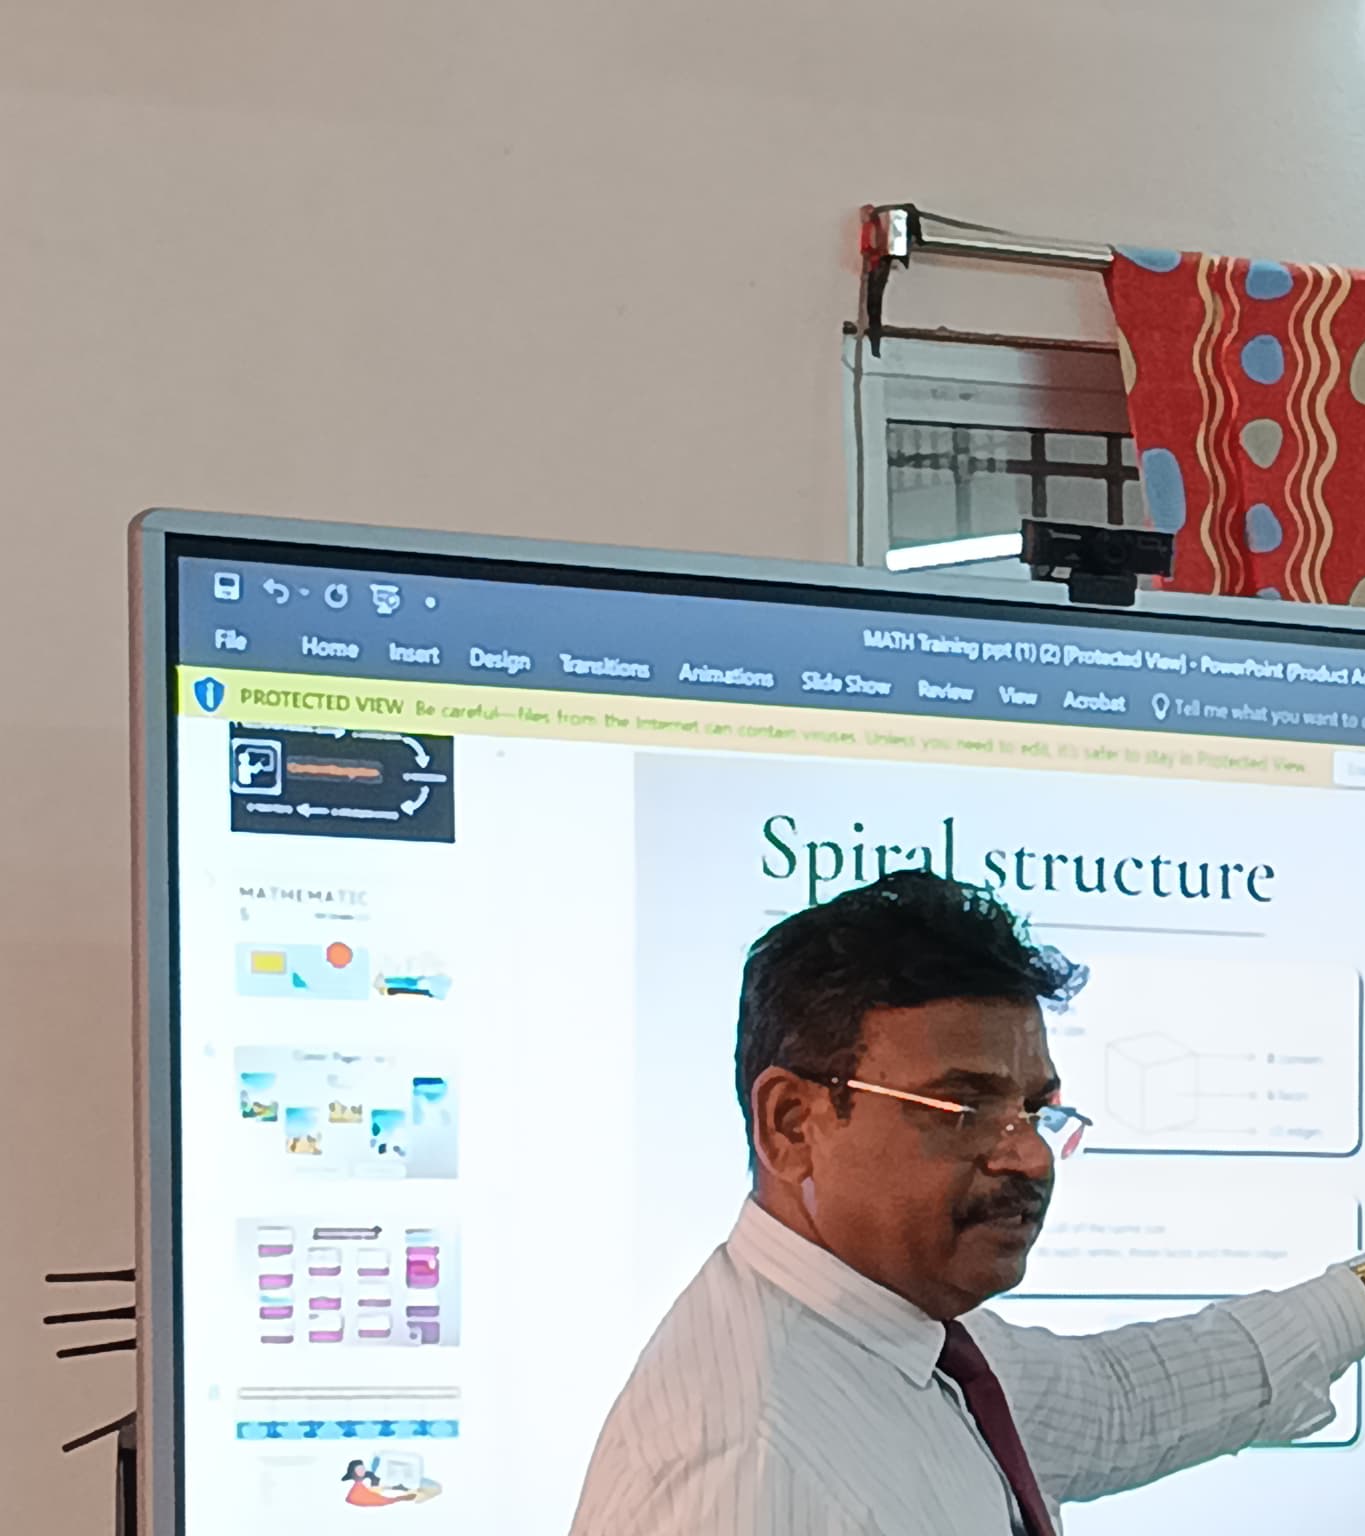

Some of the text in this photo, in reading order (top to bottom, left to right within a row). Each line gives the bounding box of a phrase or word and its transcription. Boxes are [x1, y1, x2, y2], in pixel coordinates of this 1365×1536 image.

[215, 628, 1128, 713] File Home Insert Design Transitions Animations Slide Show Review View Acrobat
[864, 629, 915, 651] MATH
[917, 632, 980, 661] Training
[1200, 655, 1284, 681] PowerPoint
[1287, 662, 1349, 685] (Product
[240, 686, 351, 711] PROTECTED
[354, 696, 405, 715] VIEW
[415, 700, 436, 717] Be
[557, 709, 598, 726] from
[604, 712, 631, 729] the
[636, 716, 699, 733] Internet
[1174, 699, 1200, 718] Tell
[1203, 704, 1230, 720] me
[1231, 703, 1268, 723] what
[1271, 709, 1301, 728] you
[1303, 710, 1339, 729] want
[1341, 711, 1359, 729] to
[761, 813, 1277, 906] Spiral structure
